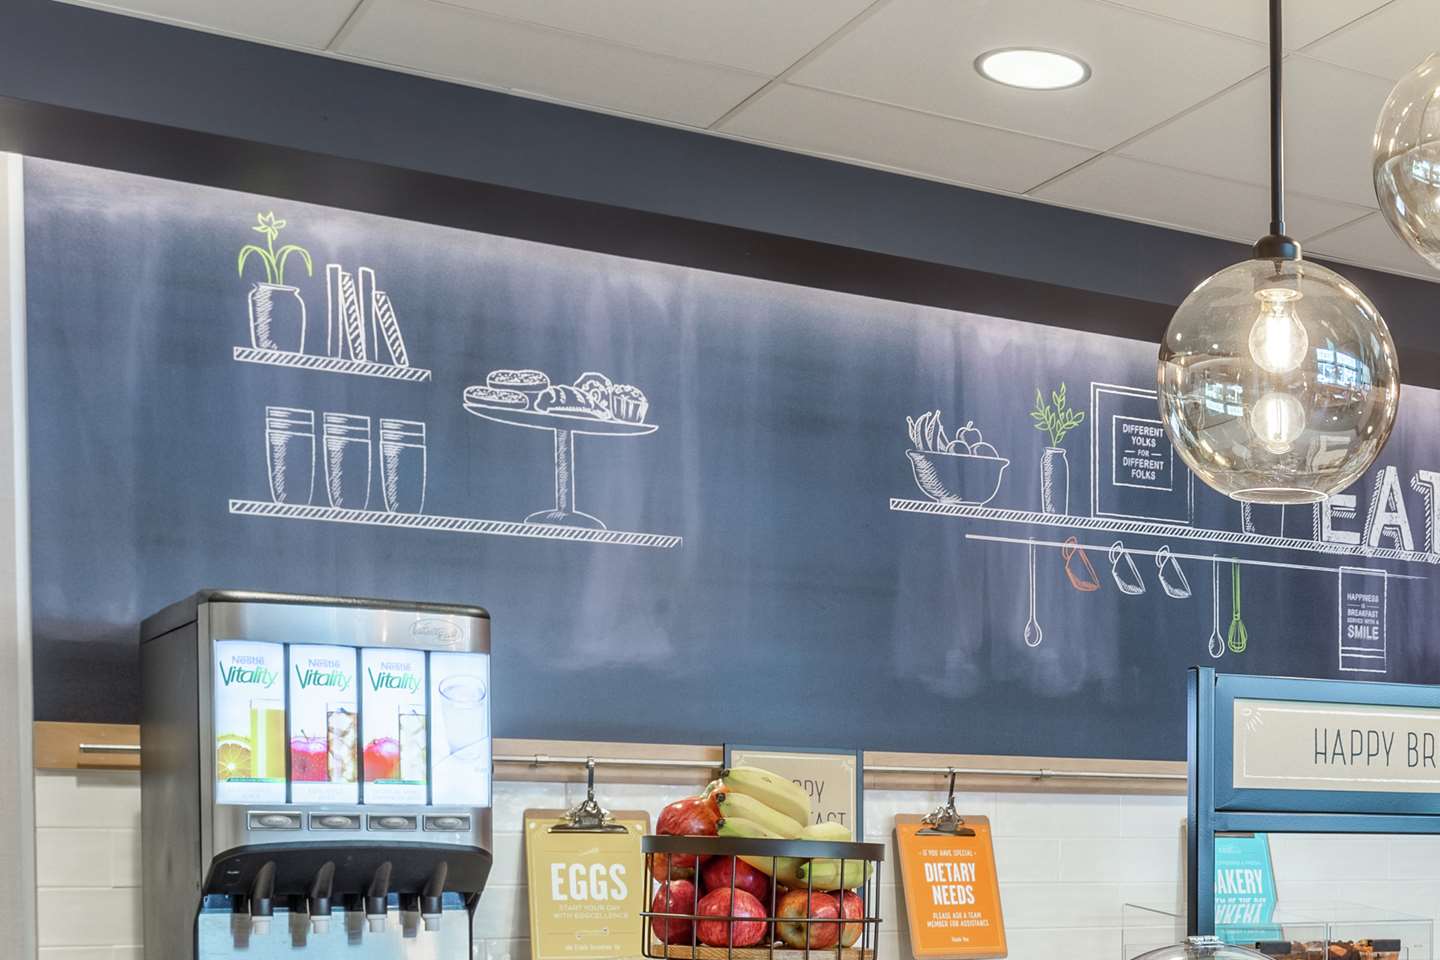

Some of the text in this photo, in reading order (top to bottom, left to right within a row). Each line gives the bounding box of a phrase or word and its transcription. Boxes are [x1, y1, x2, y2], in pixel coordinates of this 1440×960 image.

[1122, 423, 1164, 438] DIFFERENT
[1131, 436, 1157, 448] YOLKS
[1137, 449, 1150, 457] FOR
[1122, 457, 1164, 471] DIFFERENT
[1131, 469, 1156, 480] FOLKS
[1346, 593, 1379, 602] HAPPINESS
[1347, 609, 1379, 618] BREAKFAST
[1347, 625, 1379, 641] SMILE
[219, 661, 279, 689] Vitality
[295, 664, 352, 692] Vitality
[367, 667, 421, 694] Vitality
[1315, 728, 1394, 767] HAPPY
[924, 862, 976, 882] DIETARY
[551, 863, 628, 901] EGGS
[1214, 869, 1263, 894] AKERY
[932, 884, 976, 905] NEEDS
